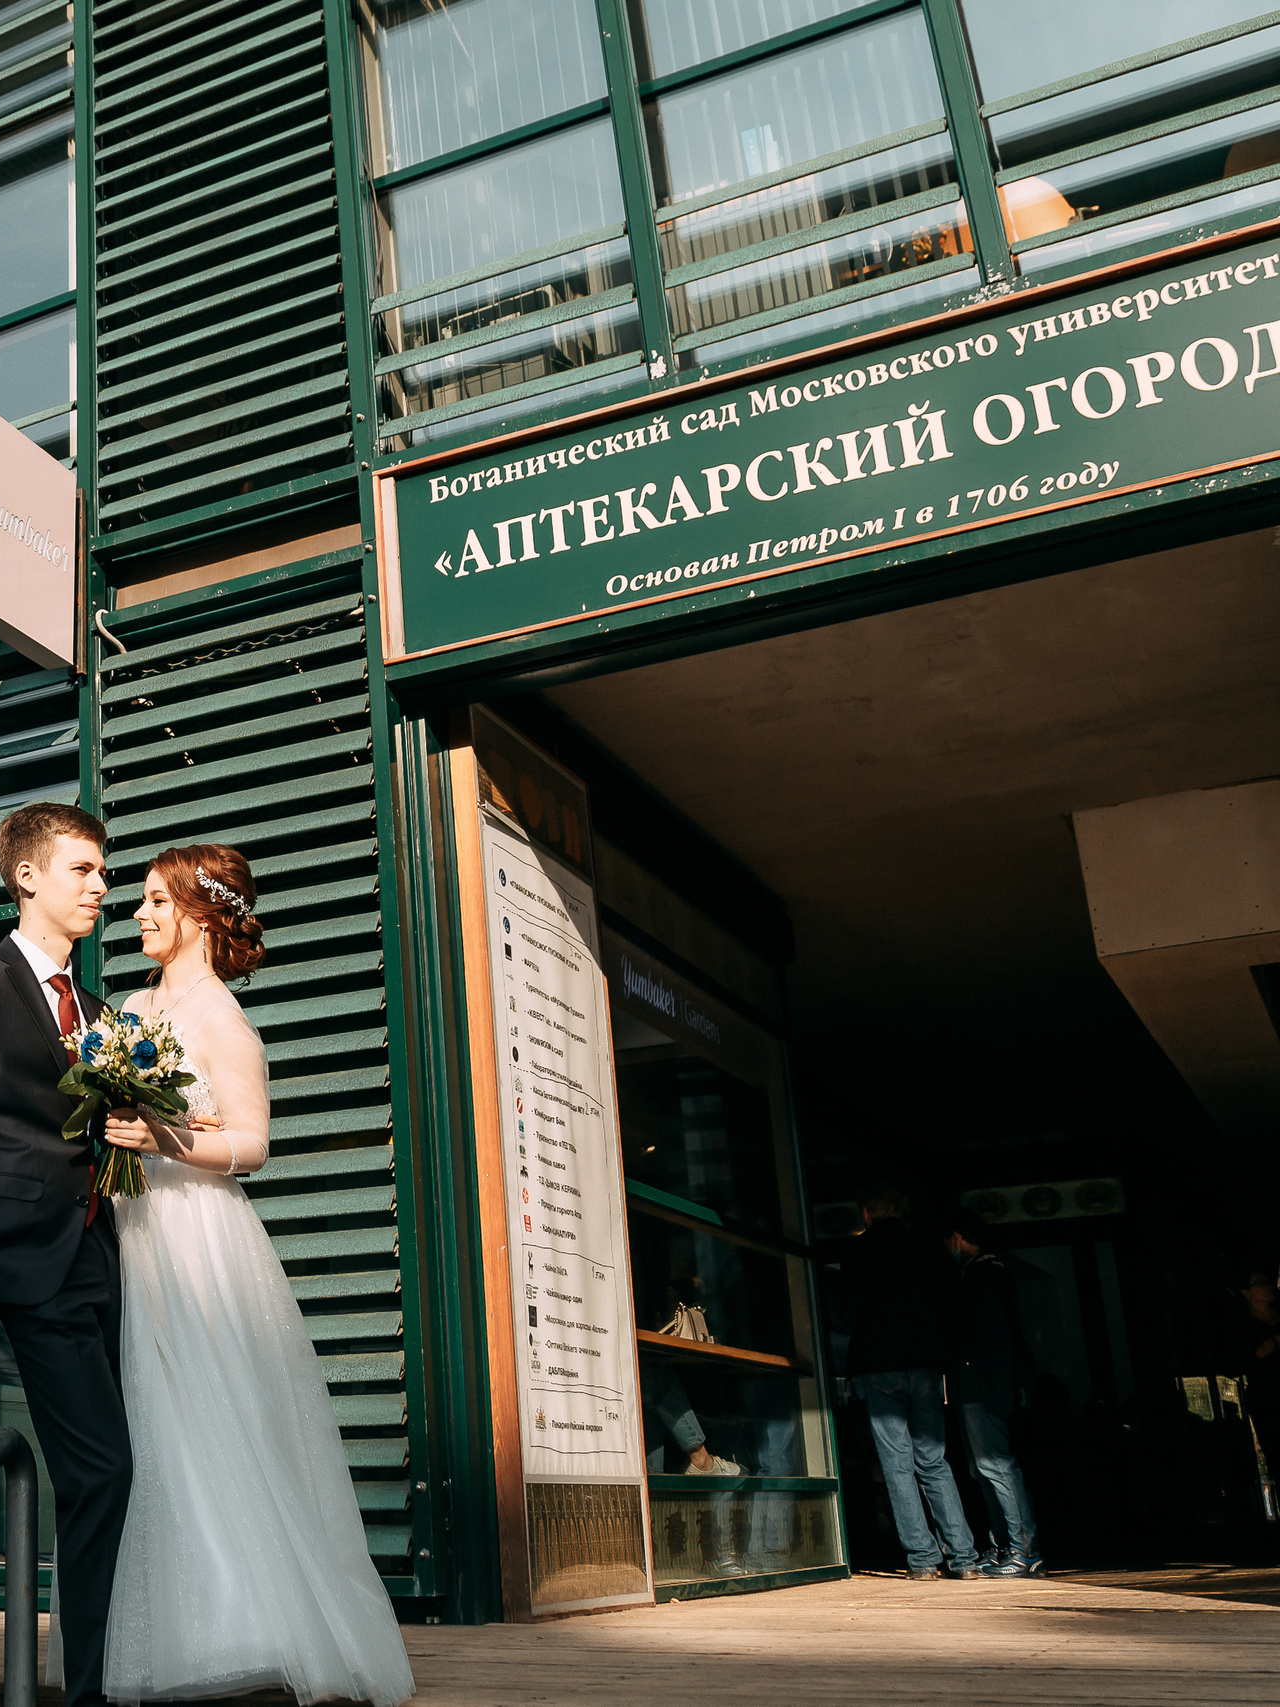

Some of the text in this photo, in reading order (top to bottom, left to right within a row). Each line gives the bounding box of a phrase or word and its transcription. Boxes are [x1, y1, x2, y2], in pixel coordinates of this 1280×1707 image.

[429, 416, 671, 504] Ботанический
[680, 403, 740, 436] сад
[748, 333, 998, 419] Московского
[434, 319, 1280, 578] «АПТЕКАРСКИЙ ОГОРОД
[605, 459, 1120, 597] Основан Петром I в 1706 году
[621, 953, 675, 1018] Yumbaker
[684, 1000, 721, 1044] Gardens
